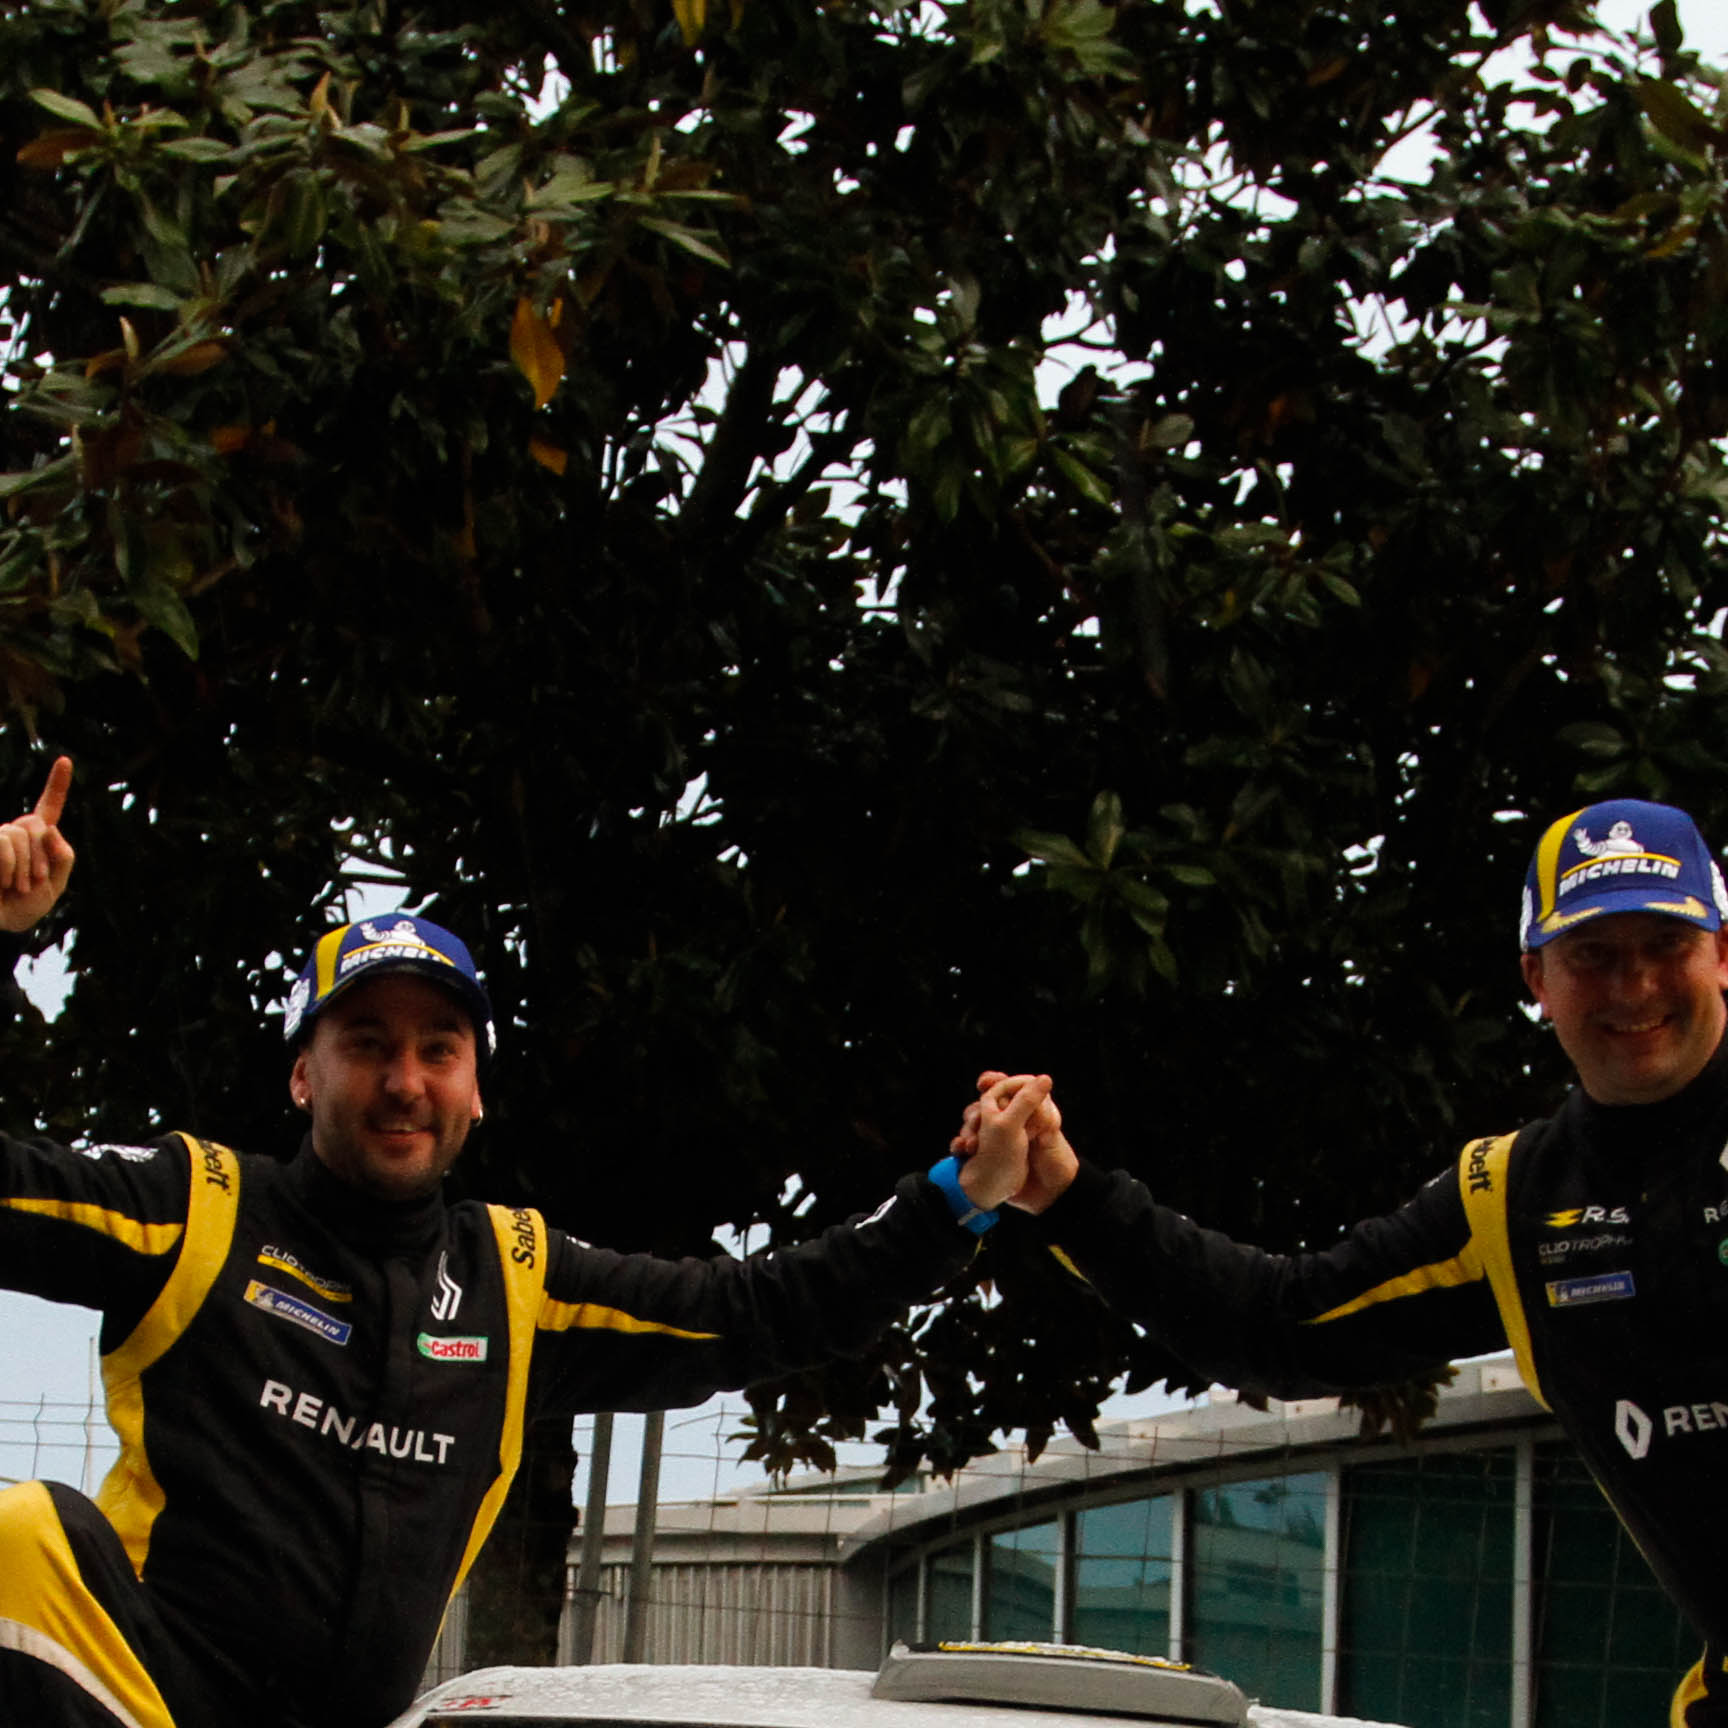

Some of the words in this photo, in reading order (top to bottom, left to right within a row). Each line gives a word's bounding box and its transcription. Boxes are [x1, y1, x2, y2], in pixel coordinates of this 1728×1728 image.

[1559, 858, 1680, 897] MICHELIN
[1581, 1206, 1630, 1224] R.S.
[511, 1209, 536, 1270] Sabe
[275, 1300, 340, 1336] MICHELIN
[431, 1338, 481, 1358] Castrol
[260, 1380, 456, 1465] RENAULT
